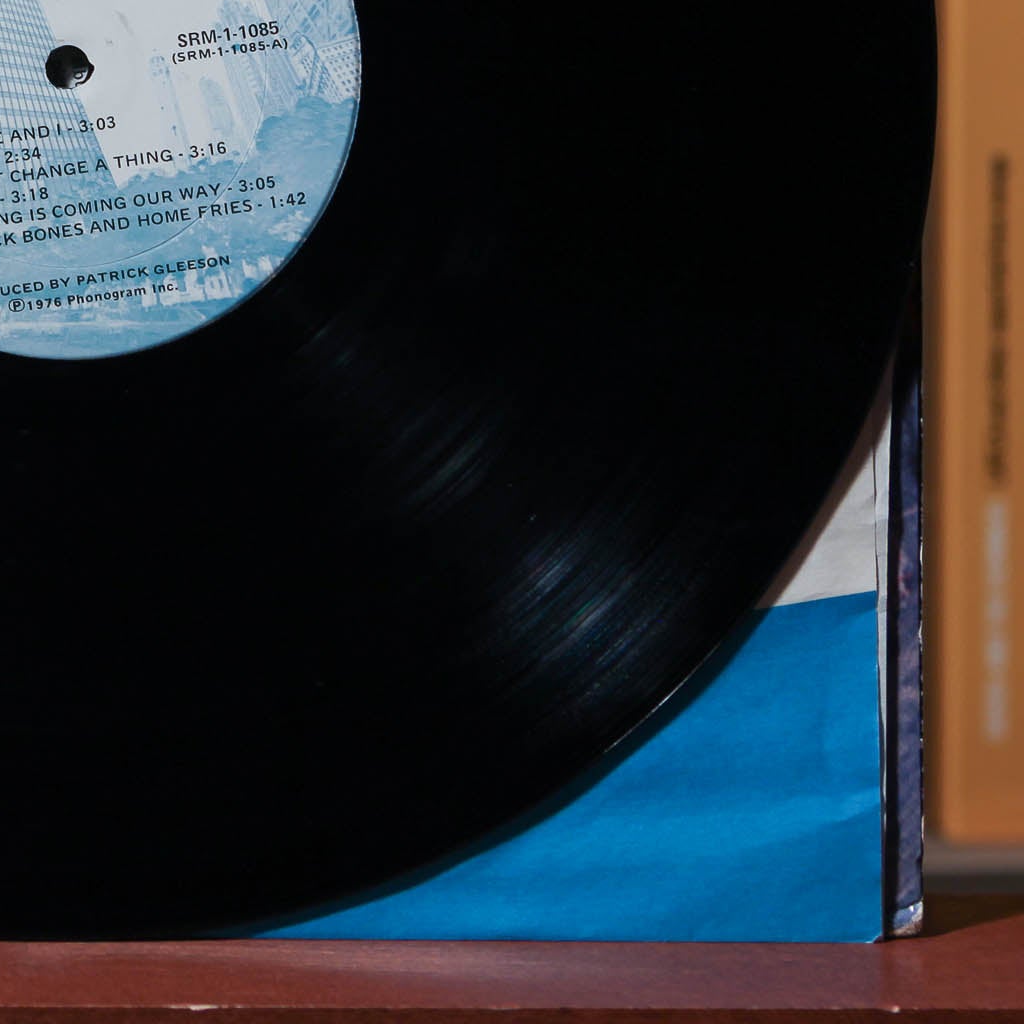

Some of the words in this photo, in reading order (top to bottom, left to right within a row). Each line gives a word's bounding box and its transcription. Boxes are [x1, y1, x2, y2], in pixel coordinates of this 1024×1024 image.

[177, 21, 279, 48] SRM-1-1085
[172, 38, 288, 65] (SRM-1-1085-A)
[10, 125, 50, 143] AND
[57, 123, 62, 136] I
[79, 116, 116, 133] 3:03
[4, 146, 42, 164] 2:34
[10, 161, 89, 183] CHANGE
[95, 159, 108, 171] A
[113, 149, 174, 169] THING
[189, 142, 227, 159] 3:16
[11, 187, 49, 204] 3:18
[30, 207, 47, 221] IS
[52, 197, 127, 218] COMING
[133, 190, 174, 208] OUR
[179, 183, 221, 201] WAY
[239, 176, 276, 193] 3:05
[22, 223, 84, 244] BONES
[90, 217, 130, 234] AND
[138, 208, 191, 227] HOME
[198, 199, 253, 219] FRIES
[270, 192, 307, 210] 1:42
[49, 277, 70, 289] BY
[76, 266, 150, 287] PATRICK
[154, 256, 231, 275] GLEESON
[67, 286, 147, 306] Phonogram
[152, 281, 179, 294] Inc.
